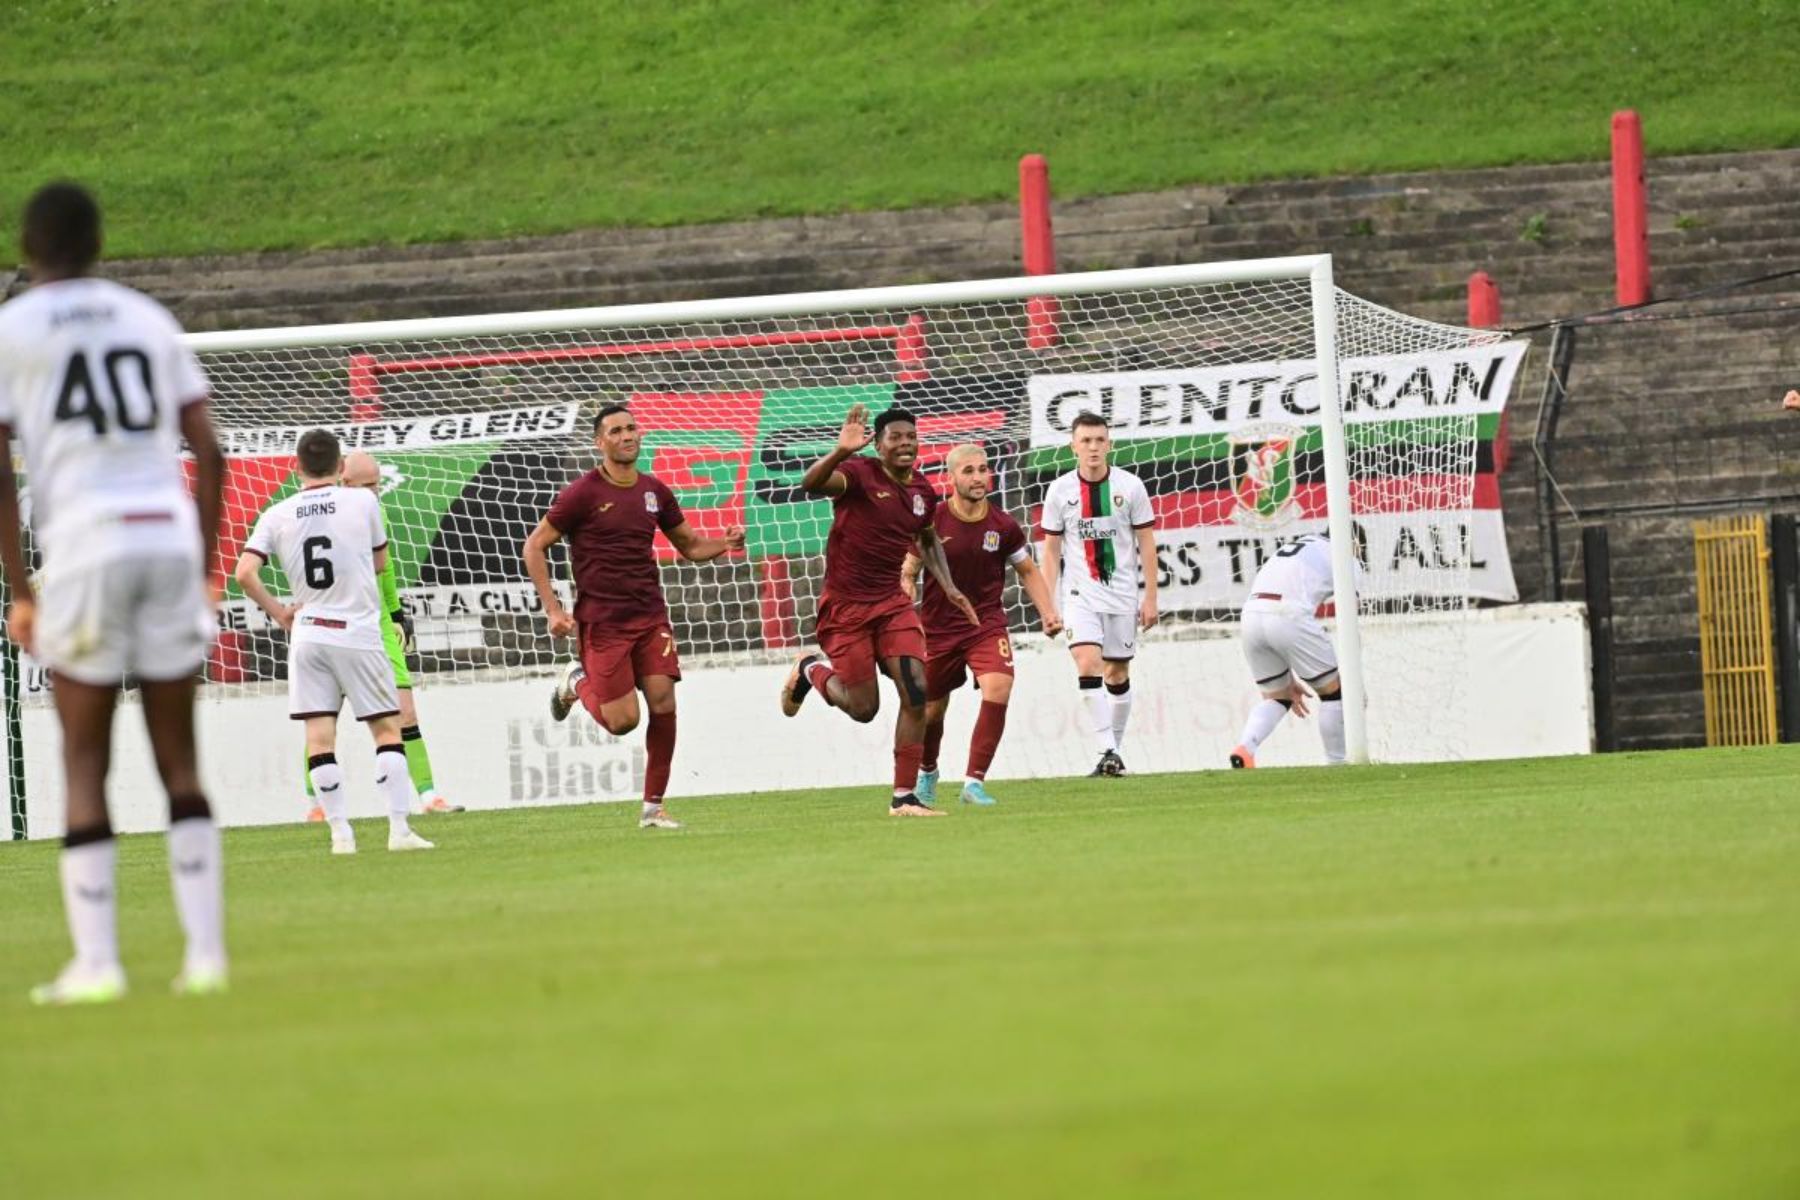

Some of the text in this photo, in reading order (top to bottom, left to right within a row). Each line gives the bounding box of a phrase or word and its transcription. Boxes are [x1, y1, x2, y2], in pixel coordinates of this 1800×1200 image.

[56, 351, 157, 434] 40
[1046, 356, 1505, 432] GLENTORAN
[429, 405, 567, 441] GLENS
[296, 502, 336, 518] BURNS
[1079, 519, 1094, 529] Bet
[1079, 529, 1117, 540] McLean
[1388, 523, 1487, 572] ALL
[303, 535, 335, 590] 6
[449, 592, 470, 613] A
[998, 638, 1010, 658] 8
